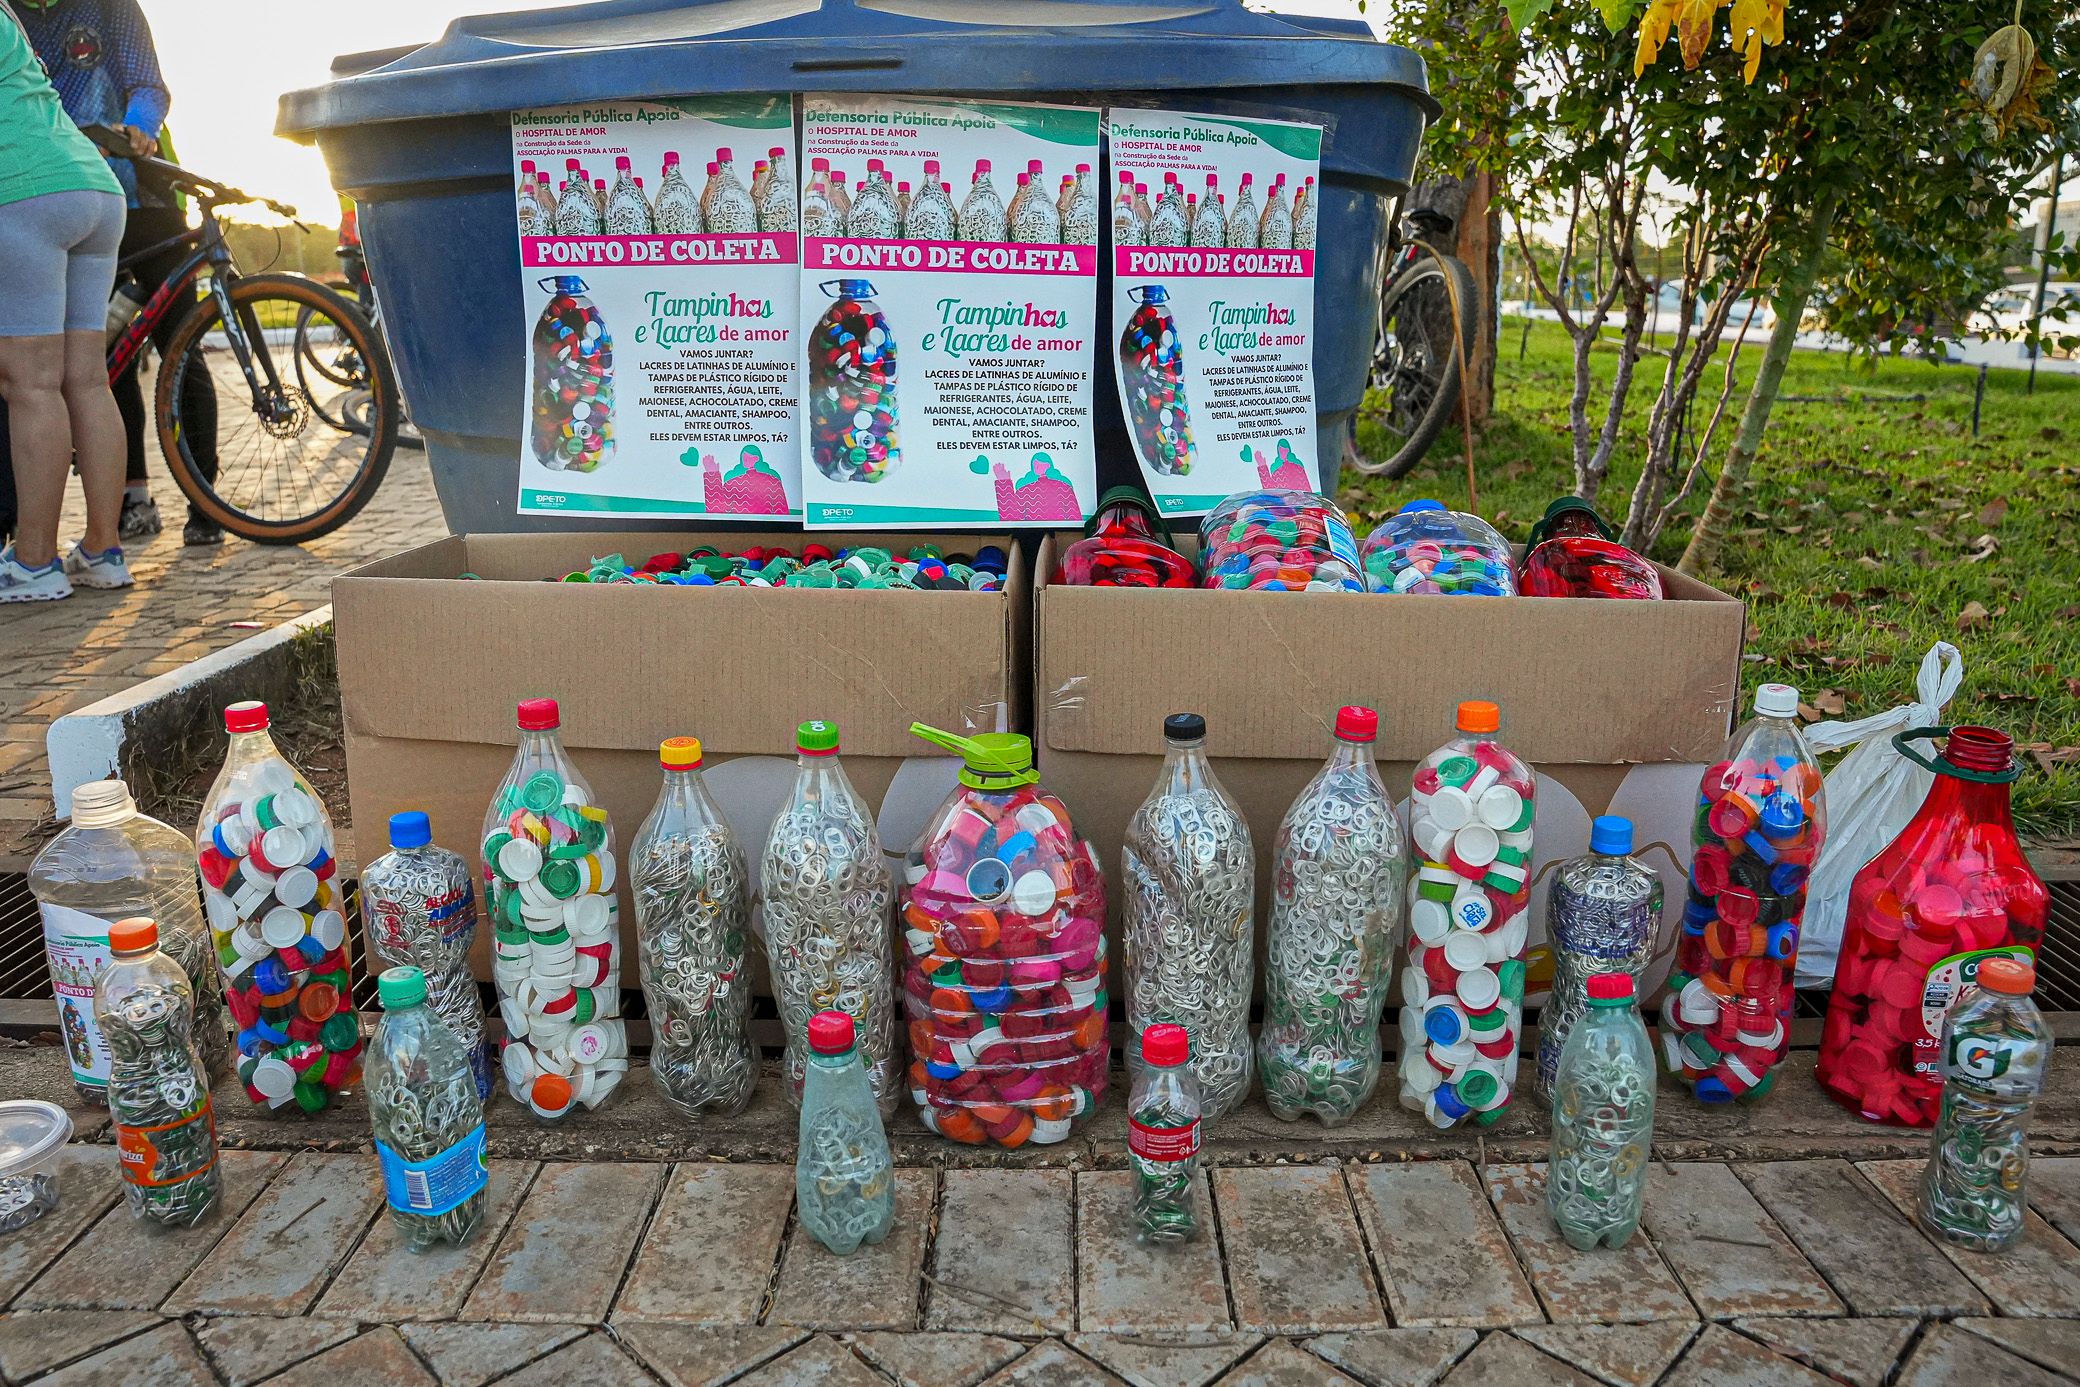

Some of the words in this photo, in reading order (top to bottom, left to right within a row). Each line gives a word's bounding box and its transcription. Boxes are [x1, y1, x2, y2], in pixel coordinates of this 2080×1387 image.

[512, 111, 579, 125] Defensoria
[583, 109, 632, 123] Pública
[636, 108, 679, 124] Apoia
[806, 110, 888, 123] Defensoria
[893, 111, 948, 126] Pública
[952, 114, 996, 131] Apoia
[522, 129, 563, 137] HOSPITAL
[816, 127, 868, 135] HOSPITAL
[870, 128, 884, 136] DE
[887, 129, 917, 137] AMOR
[1112, 124, 1180, 139] Defensoria
[1184, 128, 1224, 142] Pública
[1227, 131, 1257, 147] Apoia
[818, 139, 858, 147] Construção
[1121, 142, 1164, 150] HOSPITAL
[1180, 144, 1201, 152] AMOR
[808, 147, 856, 155] ASSOCIAÇÃO
[538, 243, 625, 262] PONTO
[630, 241, 665, 261] DE
[672, 240, 780, 260] COLETA
[822, 244, 921, 266] PONTO
[928, 247, 965, 268] DE
[971, 248, 1079, 271] COLETA
[1130, 252, 1201, 273] PONTO
[1205, 254, 1230, 272] DE
[1233, 255, 1303, 273] COLETA
[644, 291, 774, 323] Tampinhas
[937, 298, 1068, 332] Tampinhas
[1209, 301, 1296, 331] Tampinhas
[635, 325, 648, 343] e
[652, 318, 718, 350] Lacres
[720, 325, 738, 341] de
[745, 329, 789, 341] amor
[922, 332, 936, 350] e
[940, 326, 1010, 358] Lacres
[1011, 335, 1031, 350] de
[1038, 338, 1082, 350] amor
[1199, 333, 1208, 350] e
[1211, 326, 1258, 356] Lacres
[1259, 332, 1272, 346] de
[1276, 334, 1305, 346] amor
[680, 350, 712, 358] VAMOS
[715, 350, 753, 358] JUNTAR?
[1232, 355, 1254, 363] VAMOS
[1256, 354, 1281, 362] JUNTAR?
[640, 362, 672, 370] LACRES
[687, 362, 730, 370] LATINHAS
[745, 360, 788, 370] ALUMÍNIO
[1005, 359, 1045, 367] JUNTAR?
[1202, 367, 1226, 375] LACRES
[1276, 362, 1303, 372] ALUMÍNIO
[648, 374, 684, 382] TAMPAS
[686, 374, 697, 382] DE
[699, 372, 741, 382] PLÁSTICO
[744, 372, 774, 382] RÍGIDO
[925, 370, 959, 378] LACRES
[976, 371, 1019, 379] LATINHAS
[1035, 369, 1080, 379] ALUMÍNIO
[1082, 372, 1087, 380] E
[1210, 378, 1235, 386] TAMPAS
[1245, 375, 1272, 384] PLÁSTICO
[1275, 374, 1294, 382] RÍGIDO
[654, 386, 725, 395] REFRIGERANTES,
[727, 384, 756, 395] ÁGUA,
[758, 387, 782, 395] LEITE,
[988, 381, 1031, 391] PLÁSTICO
[1033, 381, 1064, 391] RÍGIDO
[1214, 388, 1263, 397] REFRIGERANTES,
[1264, 385, 1283, 394] ÁGUA,
[1284, 385, 1300, 393] LEITE,
[639, 398, 686, 406] MAIONESE,
[689, 398, 766, 407] ACHOCOLATADO,
[940, 395, 1014, 404] REFRIGERANTES,
[1016, 393, 1045, 404] ÁGUA,
[1048, 396, 1071, 404] LEITE,
[1205, 400, 1238, 409] MAIONESE,
[1240, 397, 1290, 406] ACHOCOLATADO,
[1292, 395, 1311, 403] CREME
[647, 410, 682, 418] DENTAL,
[685, 410, 739, 419] AMACIANTE,
[742, 410, 790, 419] SHAMPOO,
[924, 407, 974, 416] MAIONESE,
[977, 407, 1055, 416] ACHOCOLATADO,
[1212, 411, 1236, 419] DENTAL,
[1238, 409, 1274, 418] AMACIANTE,
[1275, 407, 1307, 415] SHAMPOO,
[714, 422, 753, 430] OUTROS.
[933, 419, 970, 427] DENTAL,
[973, 419, 1028, 427] AMACIANTE,
[1031, 419, 1080, 428] SHAMPOO,
[1258, 419, 1282, 427] OUTROS.
[650, 433, 669, 441] ELES
[734, 435, 769, 443] LIMPOS,
[772, 432, 788, 442] TÁ?
[1217, 433, 1230, 441] ELES
[1232, 431, 1251, 440] DEVEM
[1252, 430, 1270, 438] ESTAR
[1271, 428, 1294, 437] LIMPOS,
[1295, 425, 1305, 435] TÁ?
[1023, 442, 1058, 450] LIMPOS,
[1061, 440, 1077, 449] TÁ?
